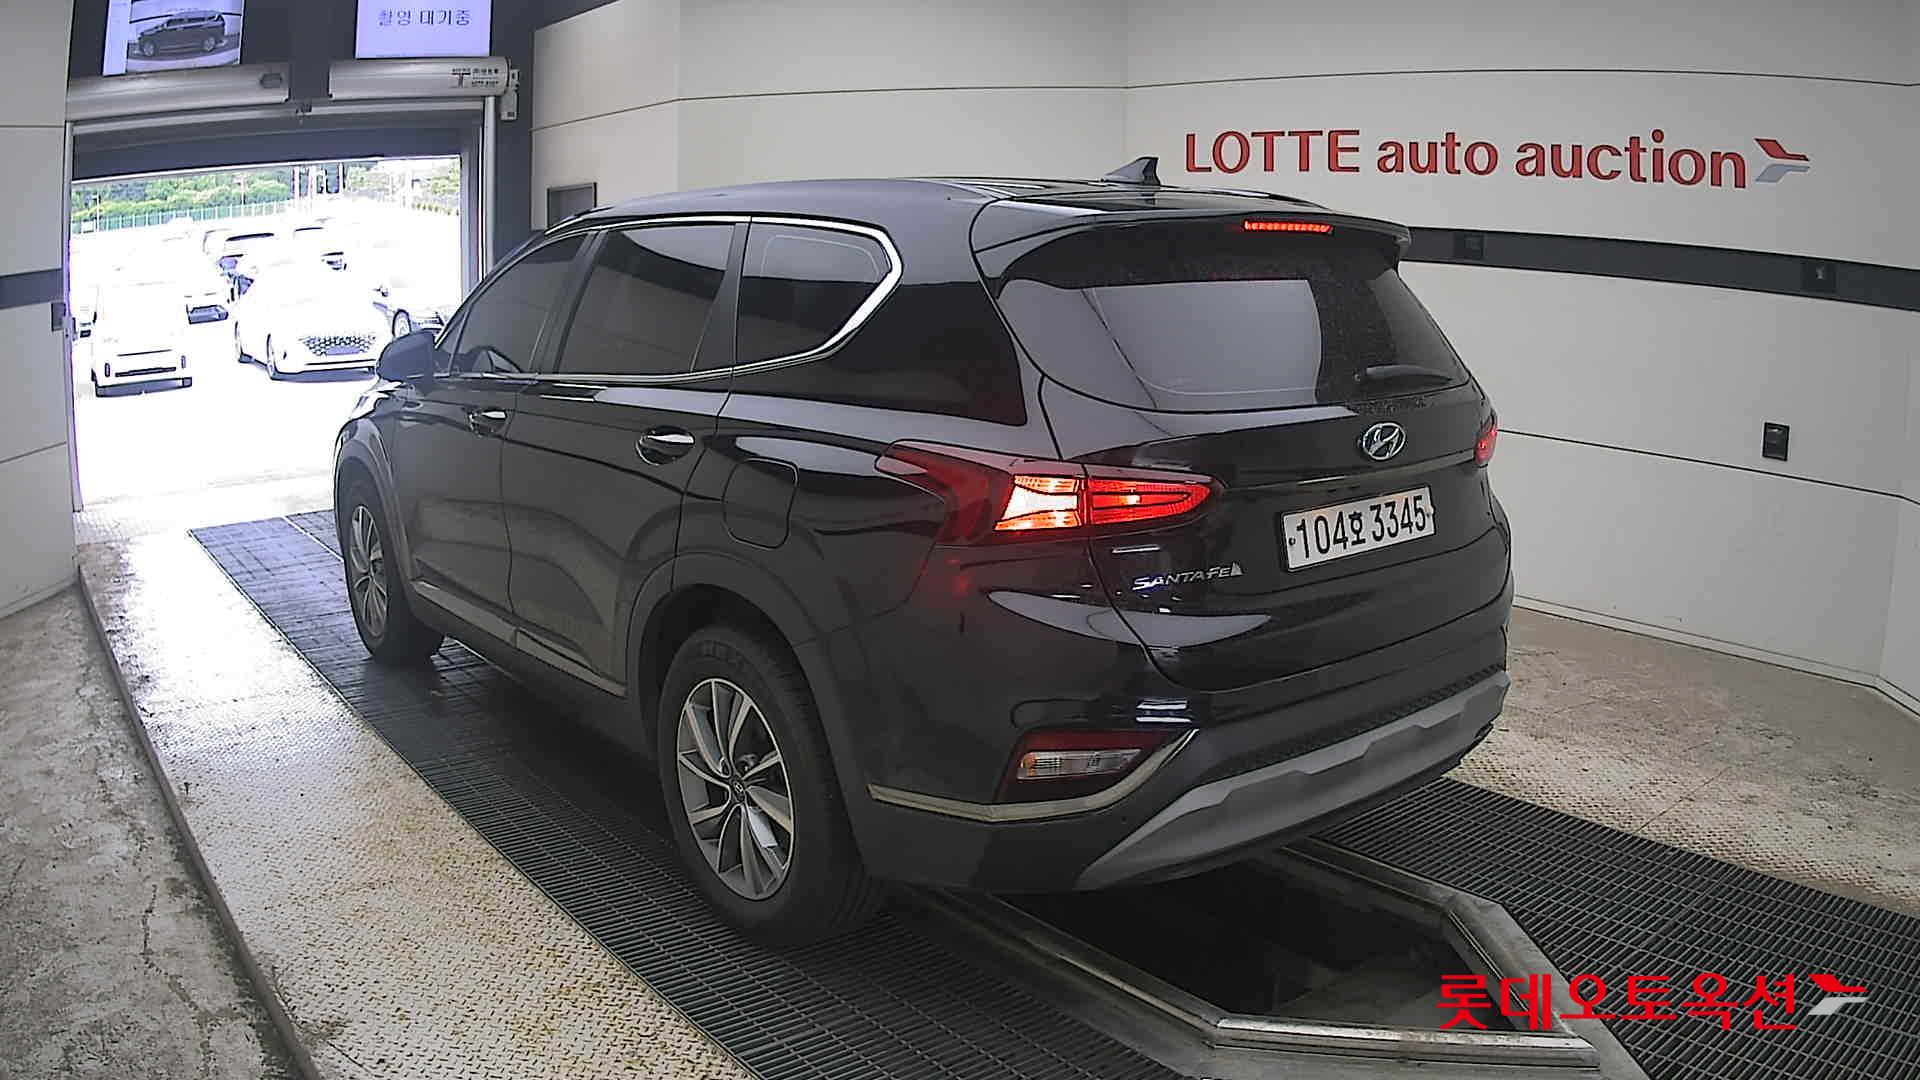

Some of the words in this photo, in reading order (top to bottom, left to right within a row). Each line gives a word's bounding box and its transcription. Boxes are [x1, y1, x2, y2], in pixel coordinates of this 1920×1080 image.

[419, 9, 470, 26] 대기중
[1186, 129, 1360, 174] LOTTE
[1377, 132, 1498, 175] auto
[1515, 129, 1746, 189] auction
